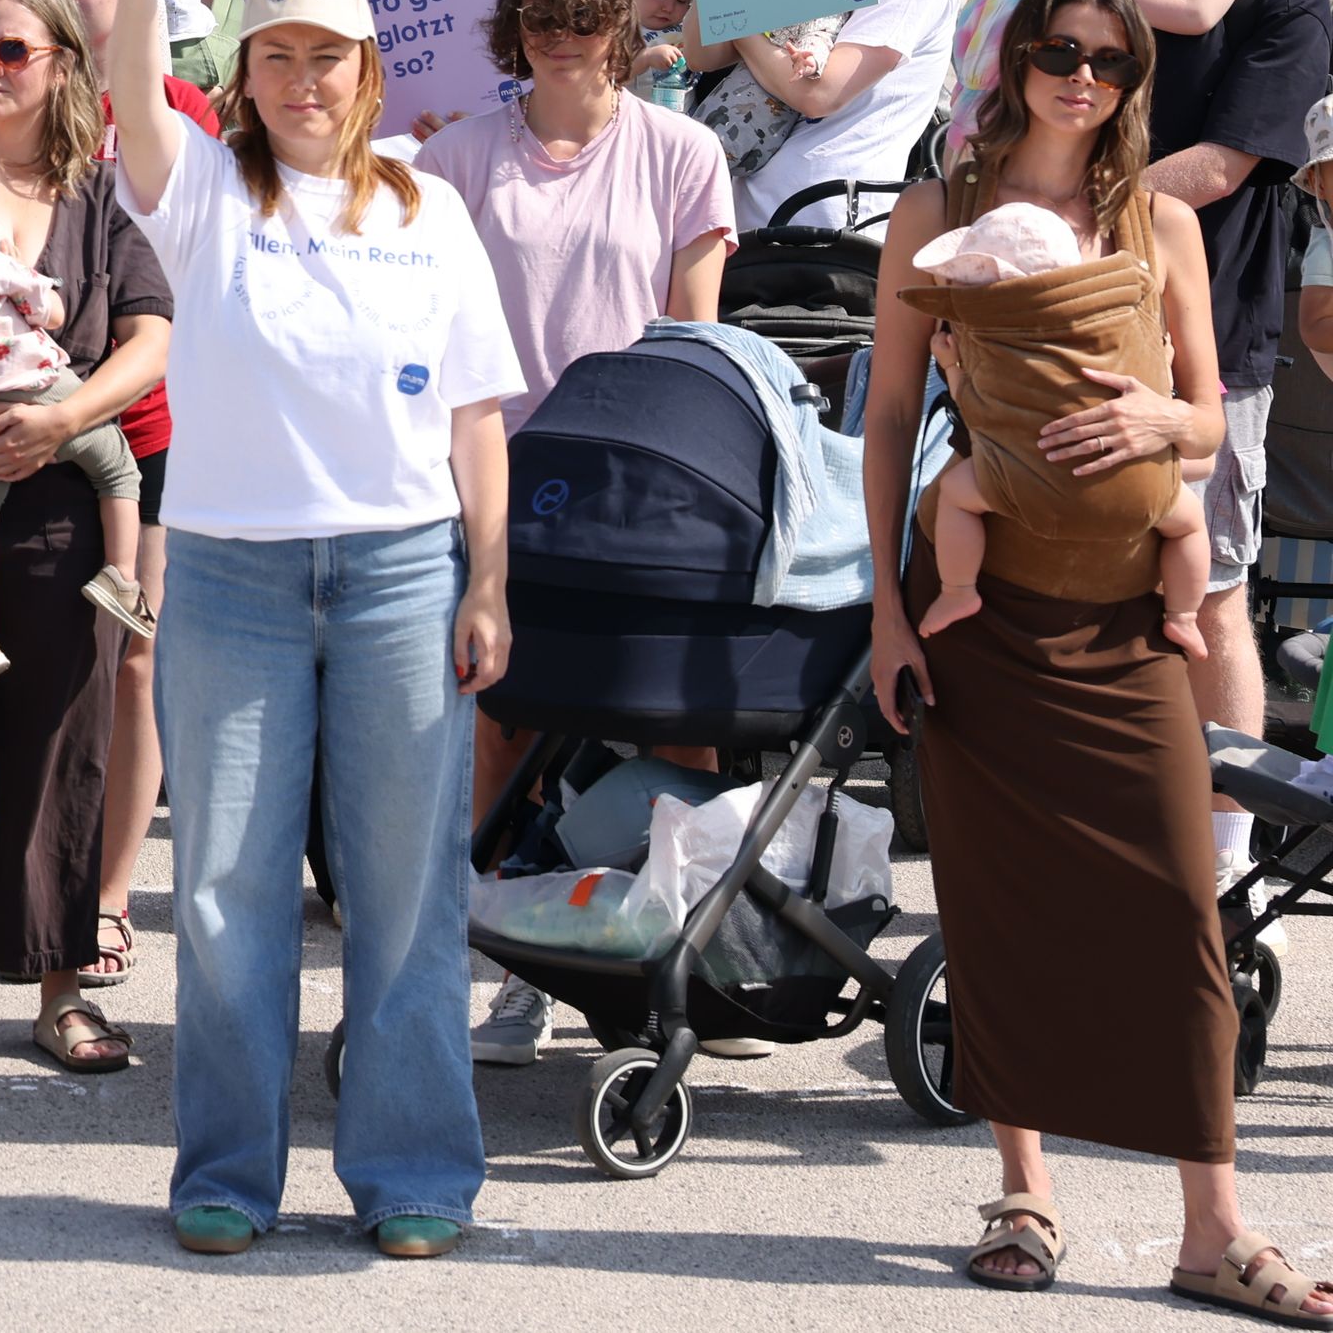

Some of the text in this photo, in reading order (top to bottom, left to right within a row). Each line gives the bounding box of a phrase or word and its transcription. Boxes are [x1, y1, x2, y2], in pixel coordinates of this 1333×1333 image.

[377, 13, 454, 53] glotzt
[393, 50, 435, 78] so?
[307, 237, 439, 269] Mein Recht.
[234, 256, 247, 280] Ich
[282, 300, 305, 317] ich
